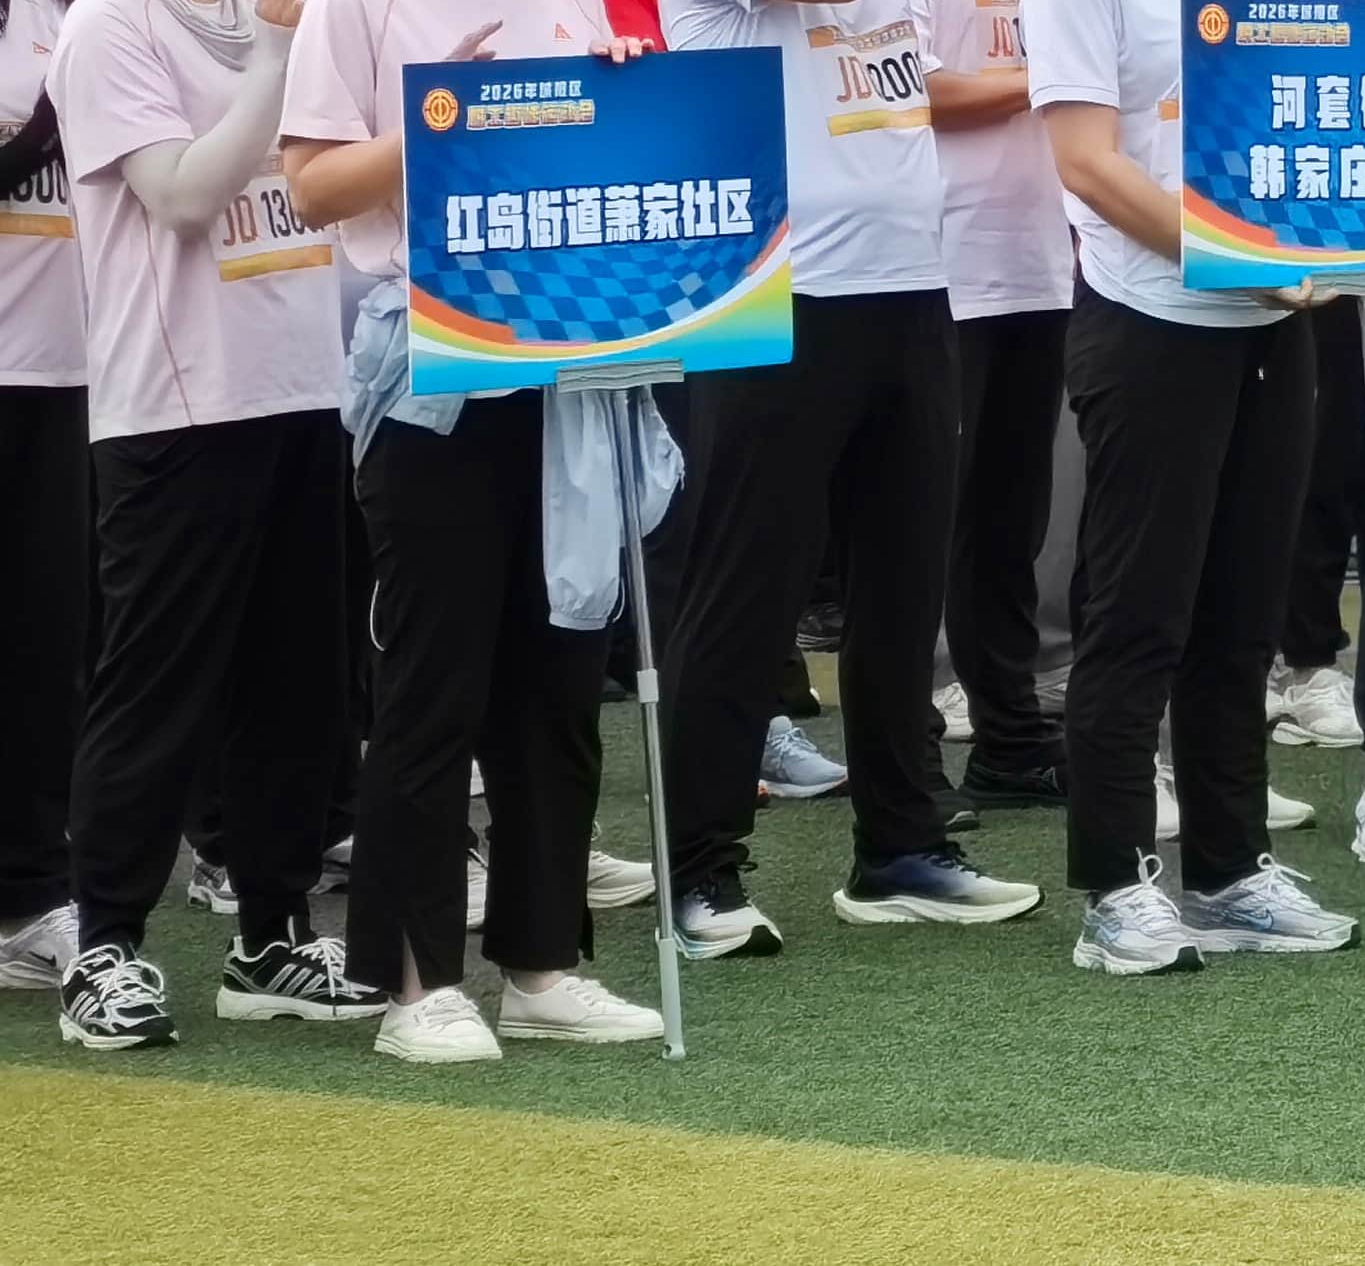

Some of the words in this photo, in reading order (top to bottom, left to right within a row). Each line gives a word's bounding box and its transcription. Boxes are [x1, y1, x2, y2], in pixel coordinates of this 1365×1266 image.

[447, 178, 754, 253] 红岛街道萧家社区
